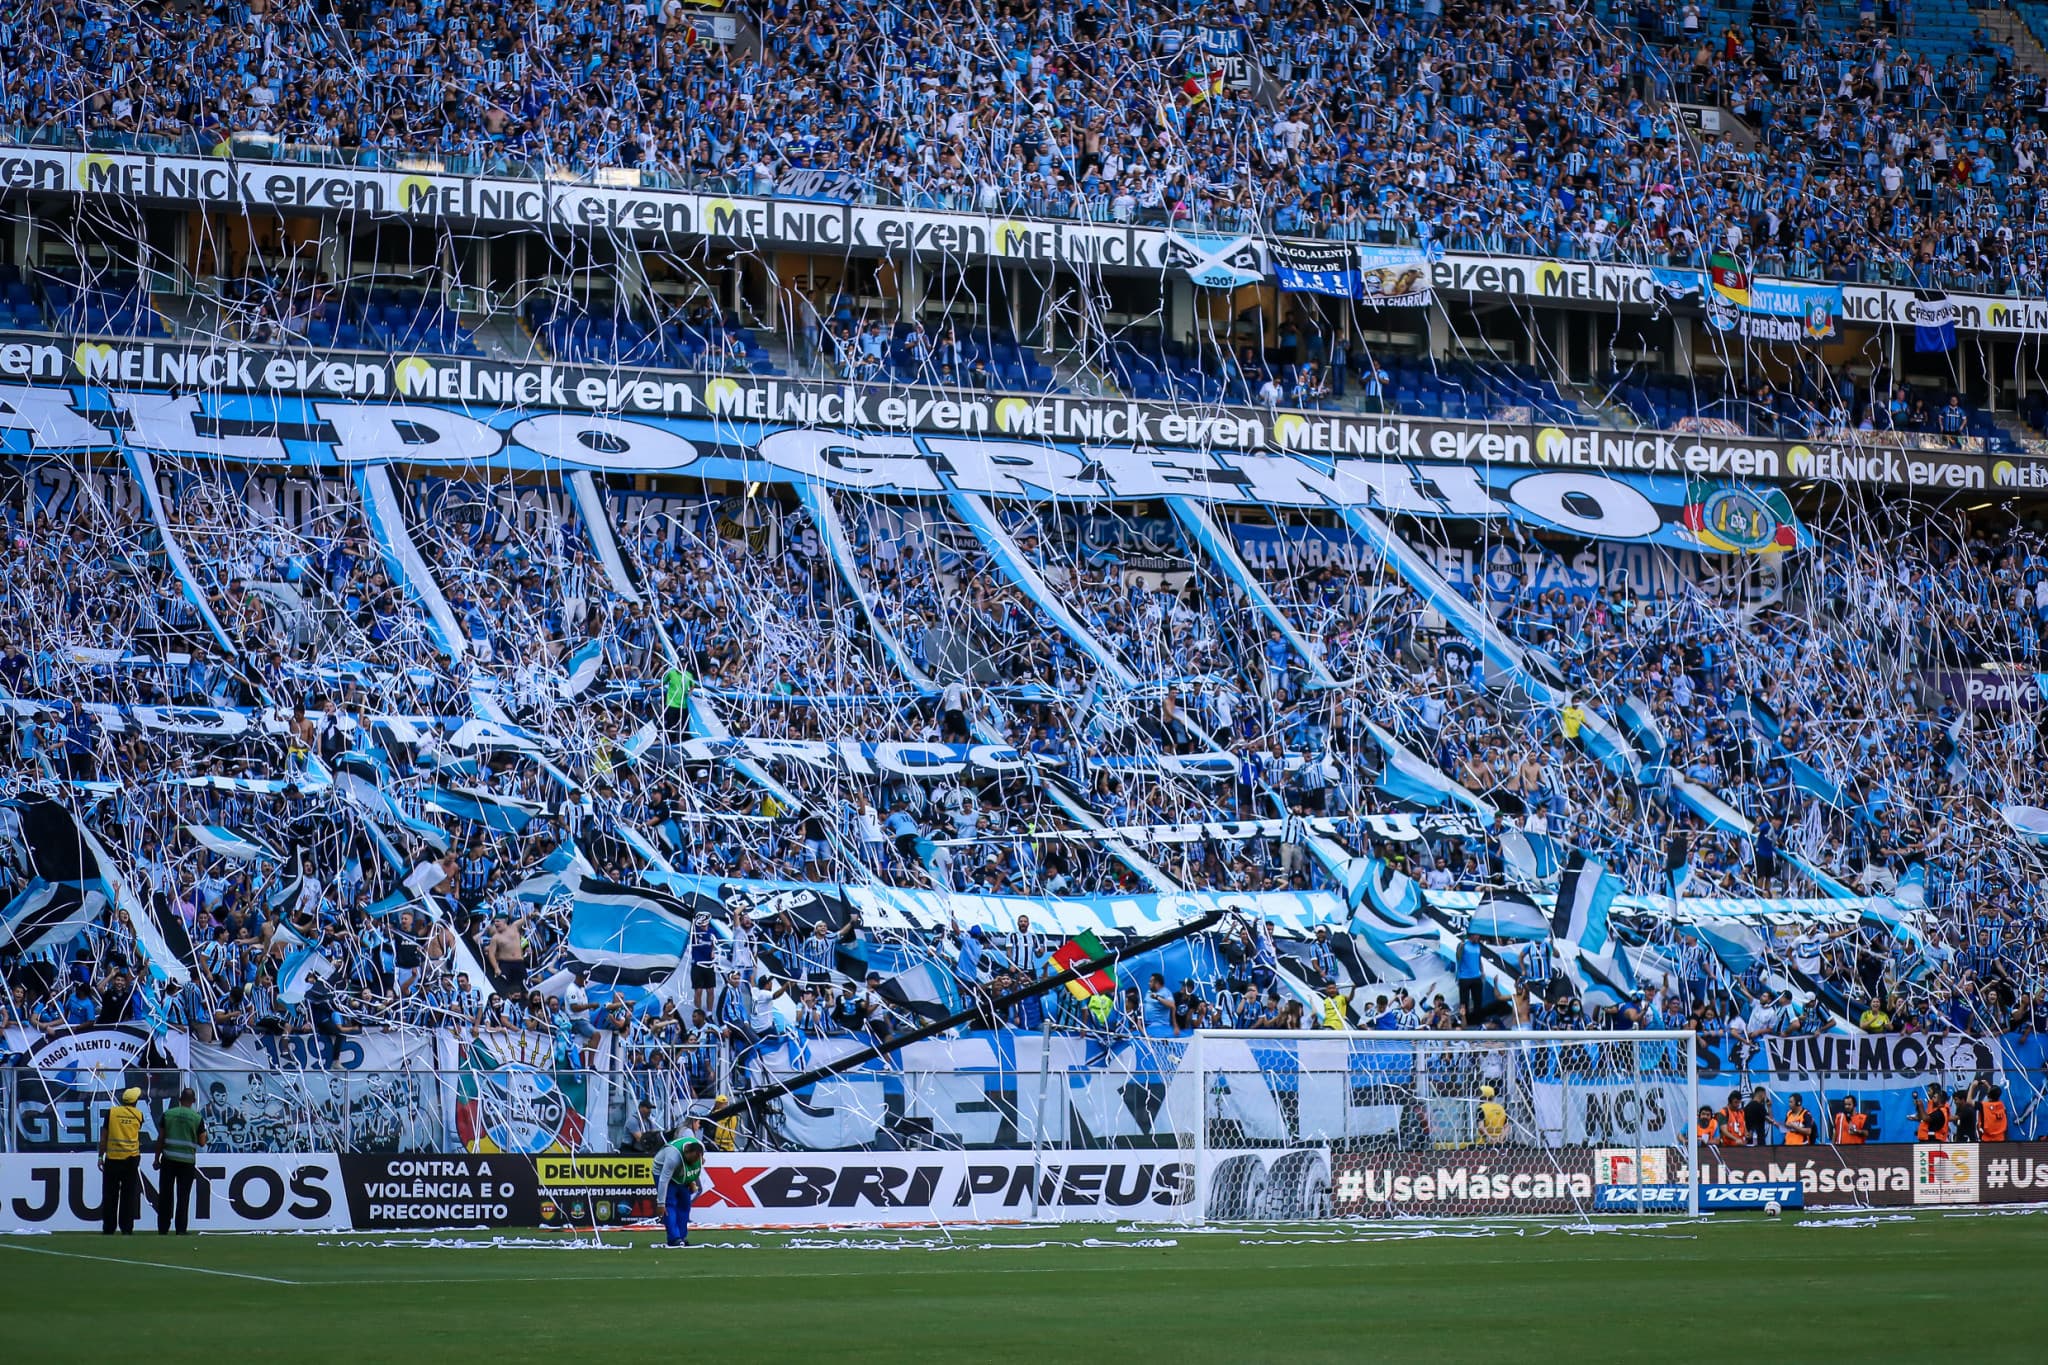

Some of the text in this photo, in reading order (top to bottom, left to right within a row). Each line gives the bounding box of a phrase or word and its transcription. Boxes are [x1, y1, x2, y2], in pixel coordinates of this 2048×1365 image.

[0, 156, 64, 190] en
[87, 156, 252, 201] MELNICK
[265, 174, 384, 210] even
[407, 177, 566, 224] MELNICK
[577, 197, 692, 232] even
[713, 202, 868, 246] MELNICK
[877, 217, 986, 256] even
[1003, 224, 1150, 266] MELNICK
[1204, 276, 1237, 286] 2009
[1292, 263, 1341, 273] AMIZADE
[1431, 262, 1652, 303] even MELNIC
[1387, 290, 1433, 307] CHARRUA
[1843, 291, 1900, 322] NICK
[0, 343, 63, 377] en
[86, 342, 256, 388] MELNICK
[265, 359, 385, 395] even
[404, 360, 569, 406] MELNICK
[576, 376, 693, 412] even
[714, 381, 873, 425] MELNICK
[878, 397, 989, 431] even
[1003, 398, 1153, 442] MELNICK
[1160, 415, 1264, 447] even
[1282, 414, 1424, 456] MELNICK
[1430, 430, 1530, 463] even
[1546, 432, 1678, 471] MELNICK
[1685, 445, 1779, 477] even
[1794, 447, 1903, 483] MELNICK
[1910, 459, 1985, 489] even
[38, 1047, 69, 1069] TRAGO
[75, 1039, 111, 1052] ALENTO
[1766, 1035, 1944, 1082] VIVEMOS
[1584, 1086, 1667, 1136] NOS
[387, 1161, 493, 1177] CONTRA A
[545, 1164, 650, 1179] DENUNCIE:
[1337, 1166, 1592, 1201] #UseMáscara
[1677, 1160, 1911, 1192] #UseMáscara
[1986, 1158, 2048, 1189] #Us
[364, 1178, 515, 1198] VIOLÊNCIA E O
[537, 1188, 586, 1196] WHATSAPP
[688, 1164, 1196, 1208] XBRI PNEUS
[1604, 1188, 1690, 1201] 1XBET
[1706, 1187, 1796, 1202] 1XBET
[370, 1204, 508, 1220] PRECONCEITO
